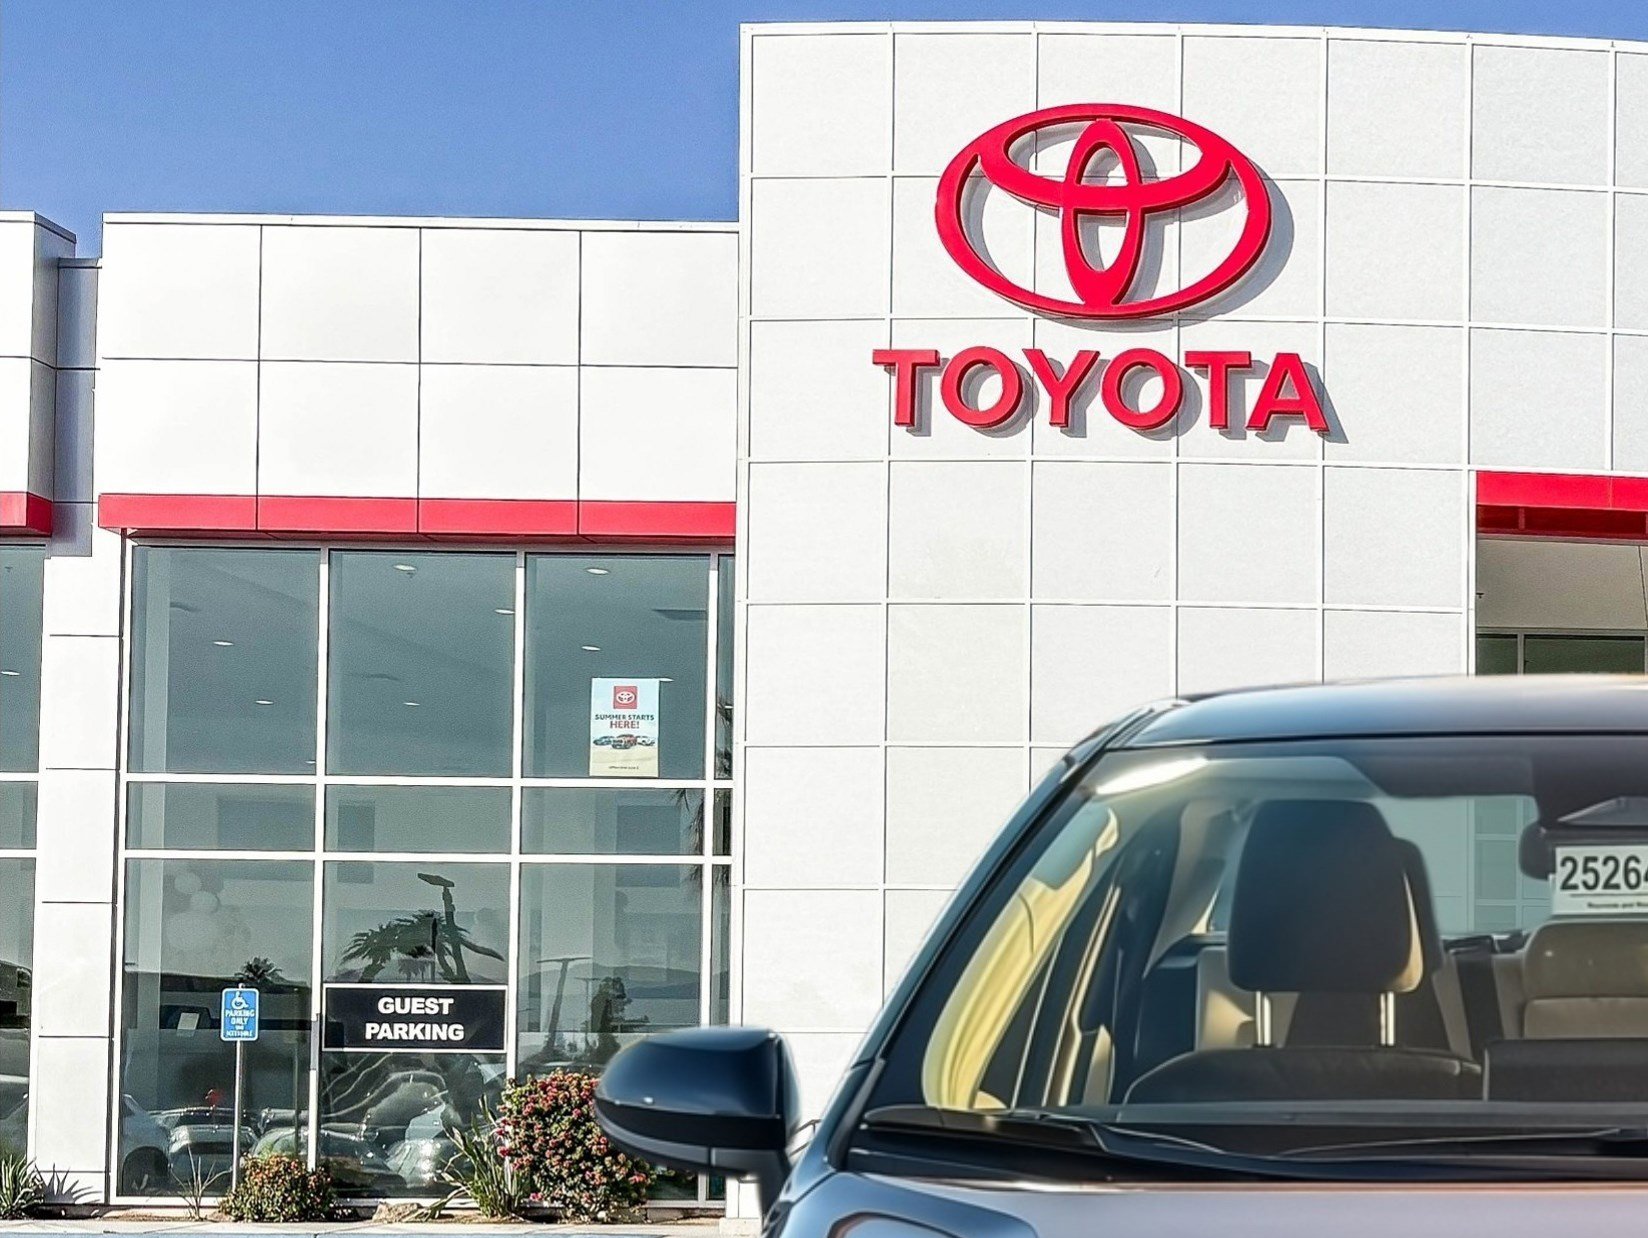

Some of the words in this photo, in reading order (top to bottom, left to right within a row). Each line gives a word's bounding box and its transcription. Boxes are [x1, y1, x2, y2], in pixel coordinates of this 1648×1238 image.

[872, 346, 1330, 434] TOYOTA
[610, 721, 640, 729] HERE!
[377, 997, 455, 1015] GUEST
[364, 1022, 465, 1041] PARKING
